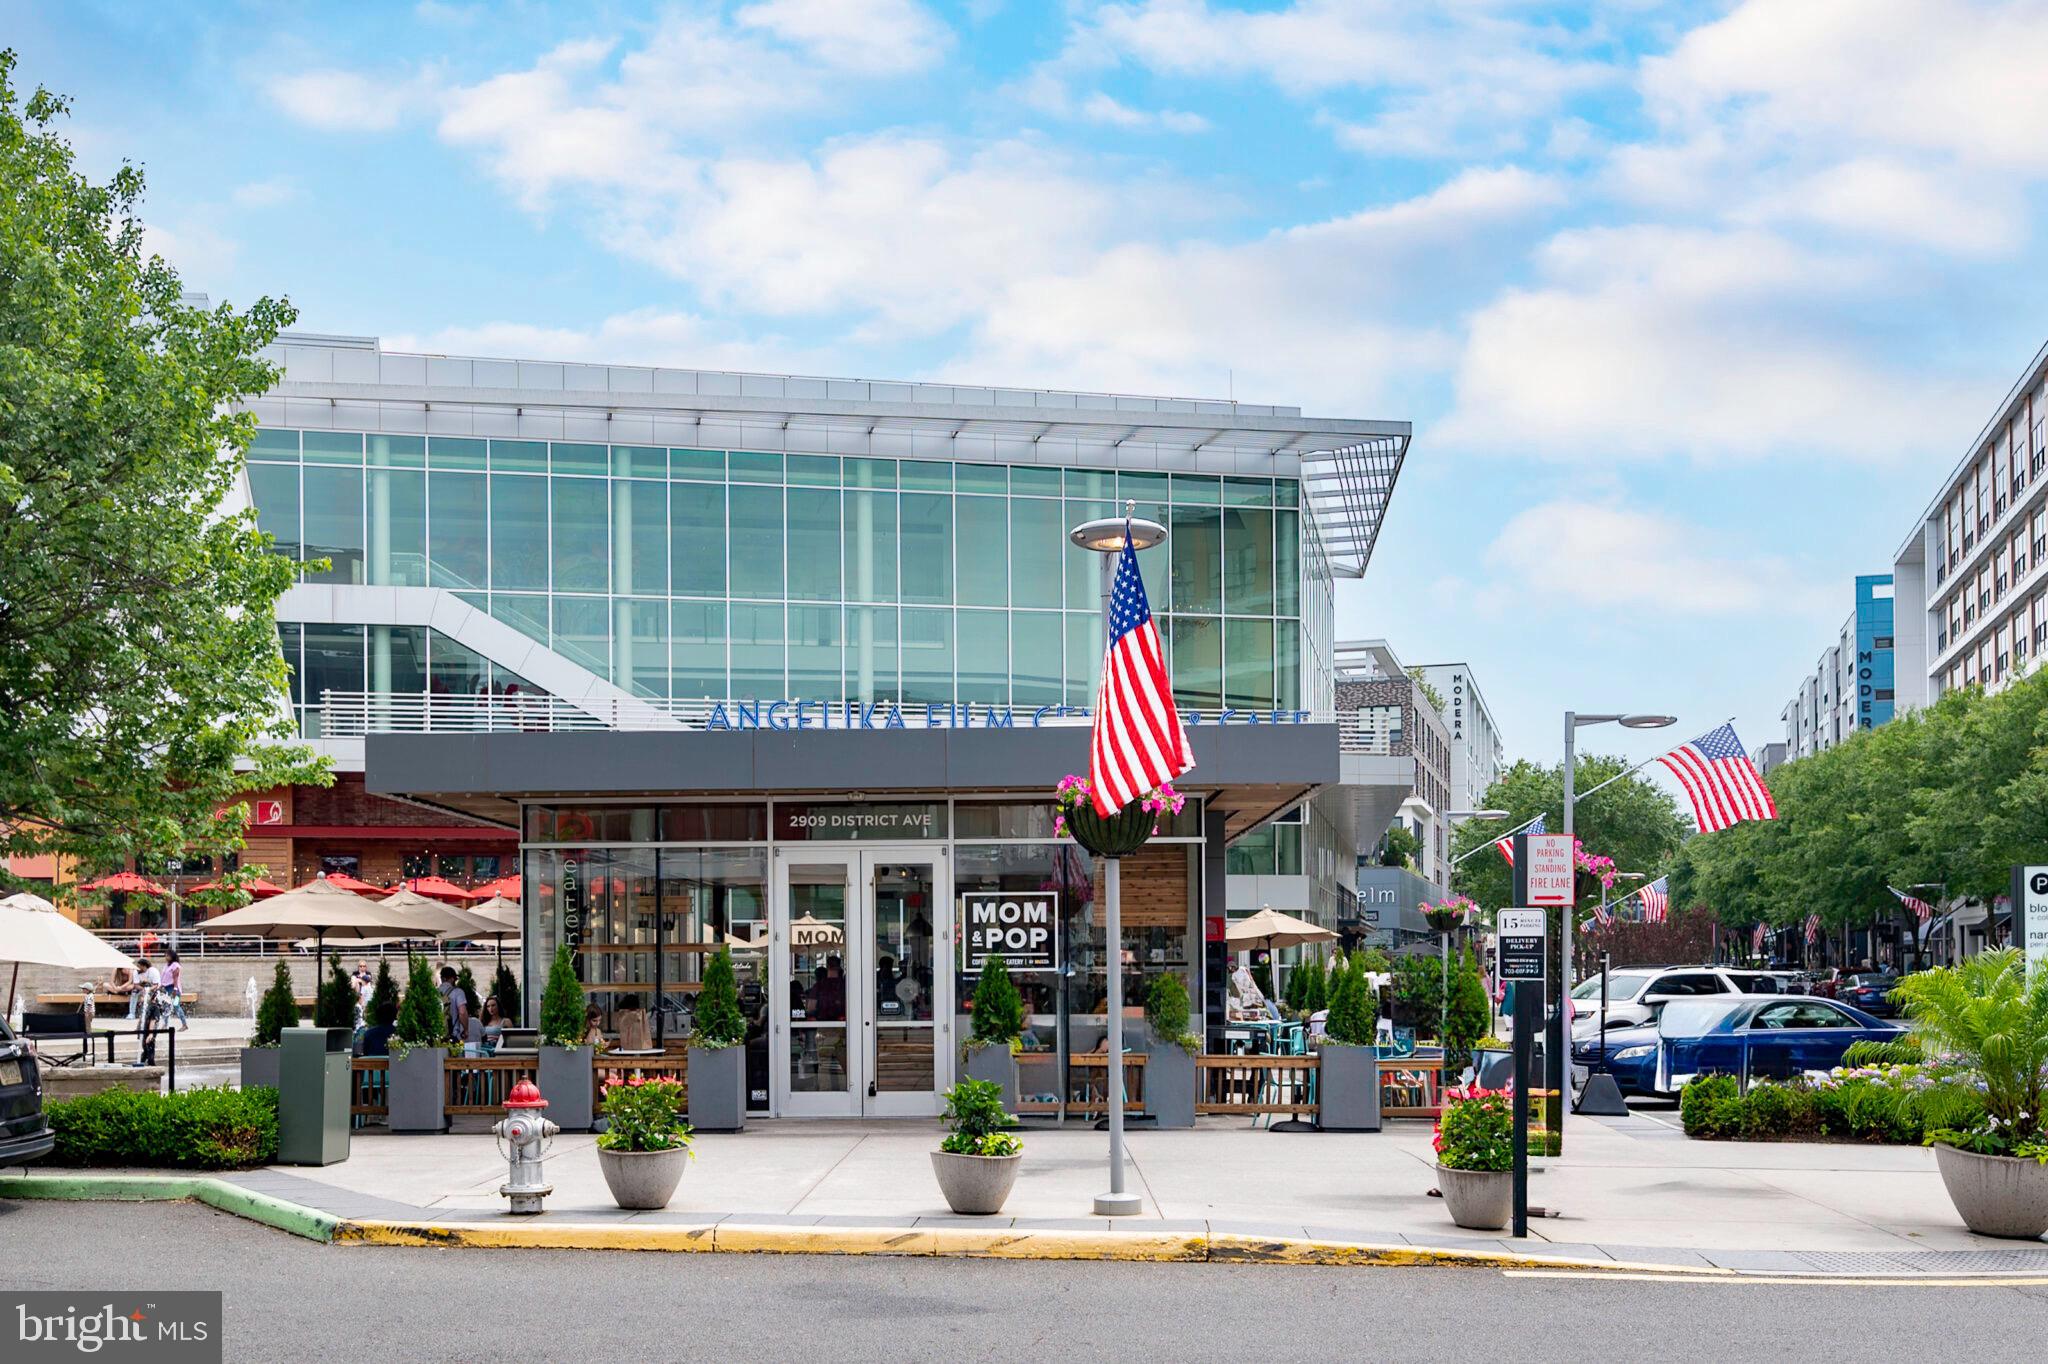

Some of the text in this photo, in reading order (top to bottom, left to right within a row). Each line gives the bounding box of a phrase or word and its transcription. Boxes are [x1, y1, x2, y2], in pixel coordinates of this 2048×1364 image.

[1453, 674, 1462, 740] MODERA
[706, 700, 906, 731] ANGELIKA
[789, 814, 932, 827] 2909 DISTRICT AVE
[1545, 838, 1556, 848] NO
[1536, 848, 1565, 857] PARKING
[1534, 864, 1567, 873] STANDING
[1530, 877, 1571, 889] FIRE LANE
[1356, 886, 1395, 903] elm
[972, 902, 1047, 924] MOM
[1503, 918, 1518, 929] 15
[797, 930, 845, 945] MOM
[972, 927, 1048, 949] & POP
